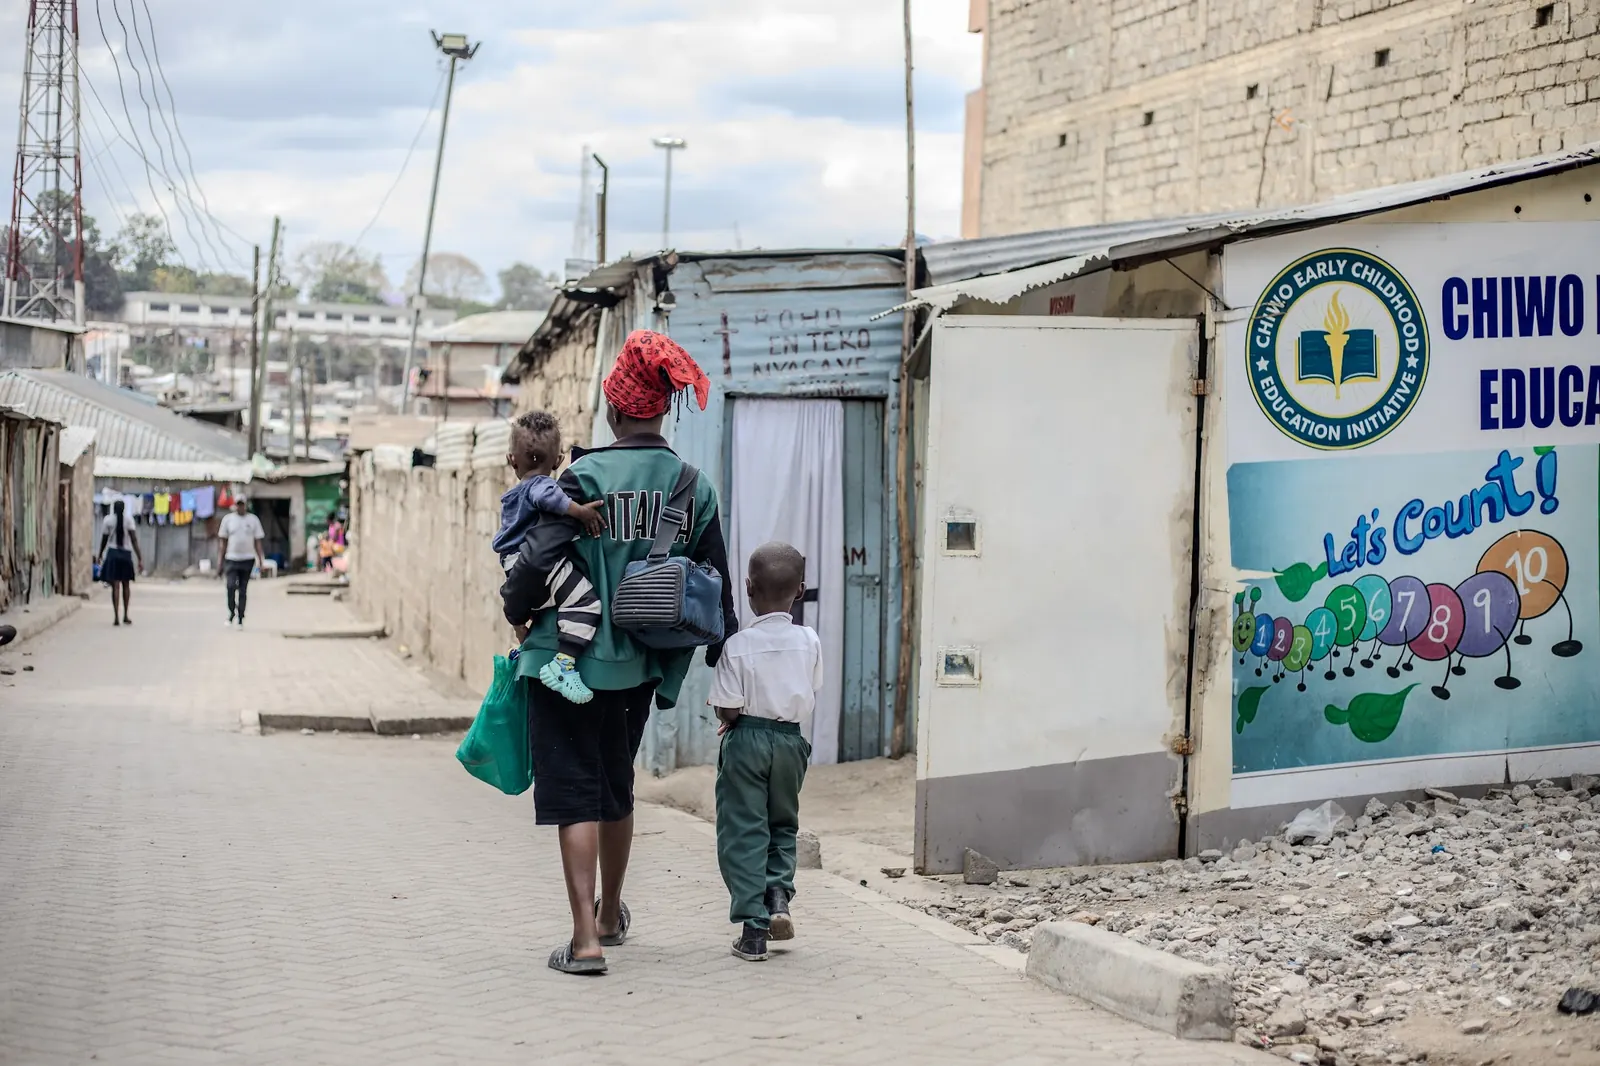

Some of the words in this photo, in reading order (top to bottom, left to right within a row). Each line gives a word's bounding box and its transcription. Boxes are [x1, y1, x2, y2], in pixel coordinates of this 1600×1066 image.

[1256, 284, 1294, 348] CHIWO
[1293, 259, 1348, 289] EARLY
[1351, 261, 1419, 352] CHILDHOOD
[1441, 274, 1584, 340] CHIWO
[1260, 375, 1341, 441] EDUCATION
[1347, 371, 1417, 440] INITIATIVE
[607, 490, 695, 543] ITALA
[1324, 507, 1386, 577] Let's
[1257, 624, 1266, 648] 1
[1274, 629, 1286, 652] 2
[1290, 637, 1306, 664] 3
[1314, 614, 1331, 648] 4
[1340, 595, 1357, 631] 5
[1368, 588, 1385, 622] 6
[1397, 591, 1416, 632] 7
[1428, 605, 1451, 643] 8
[1473, 588, 1491, 633] 9
[1505, 546, 1548, 596] 10
